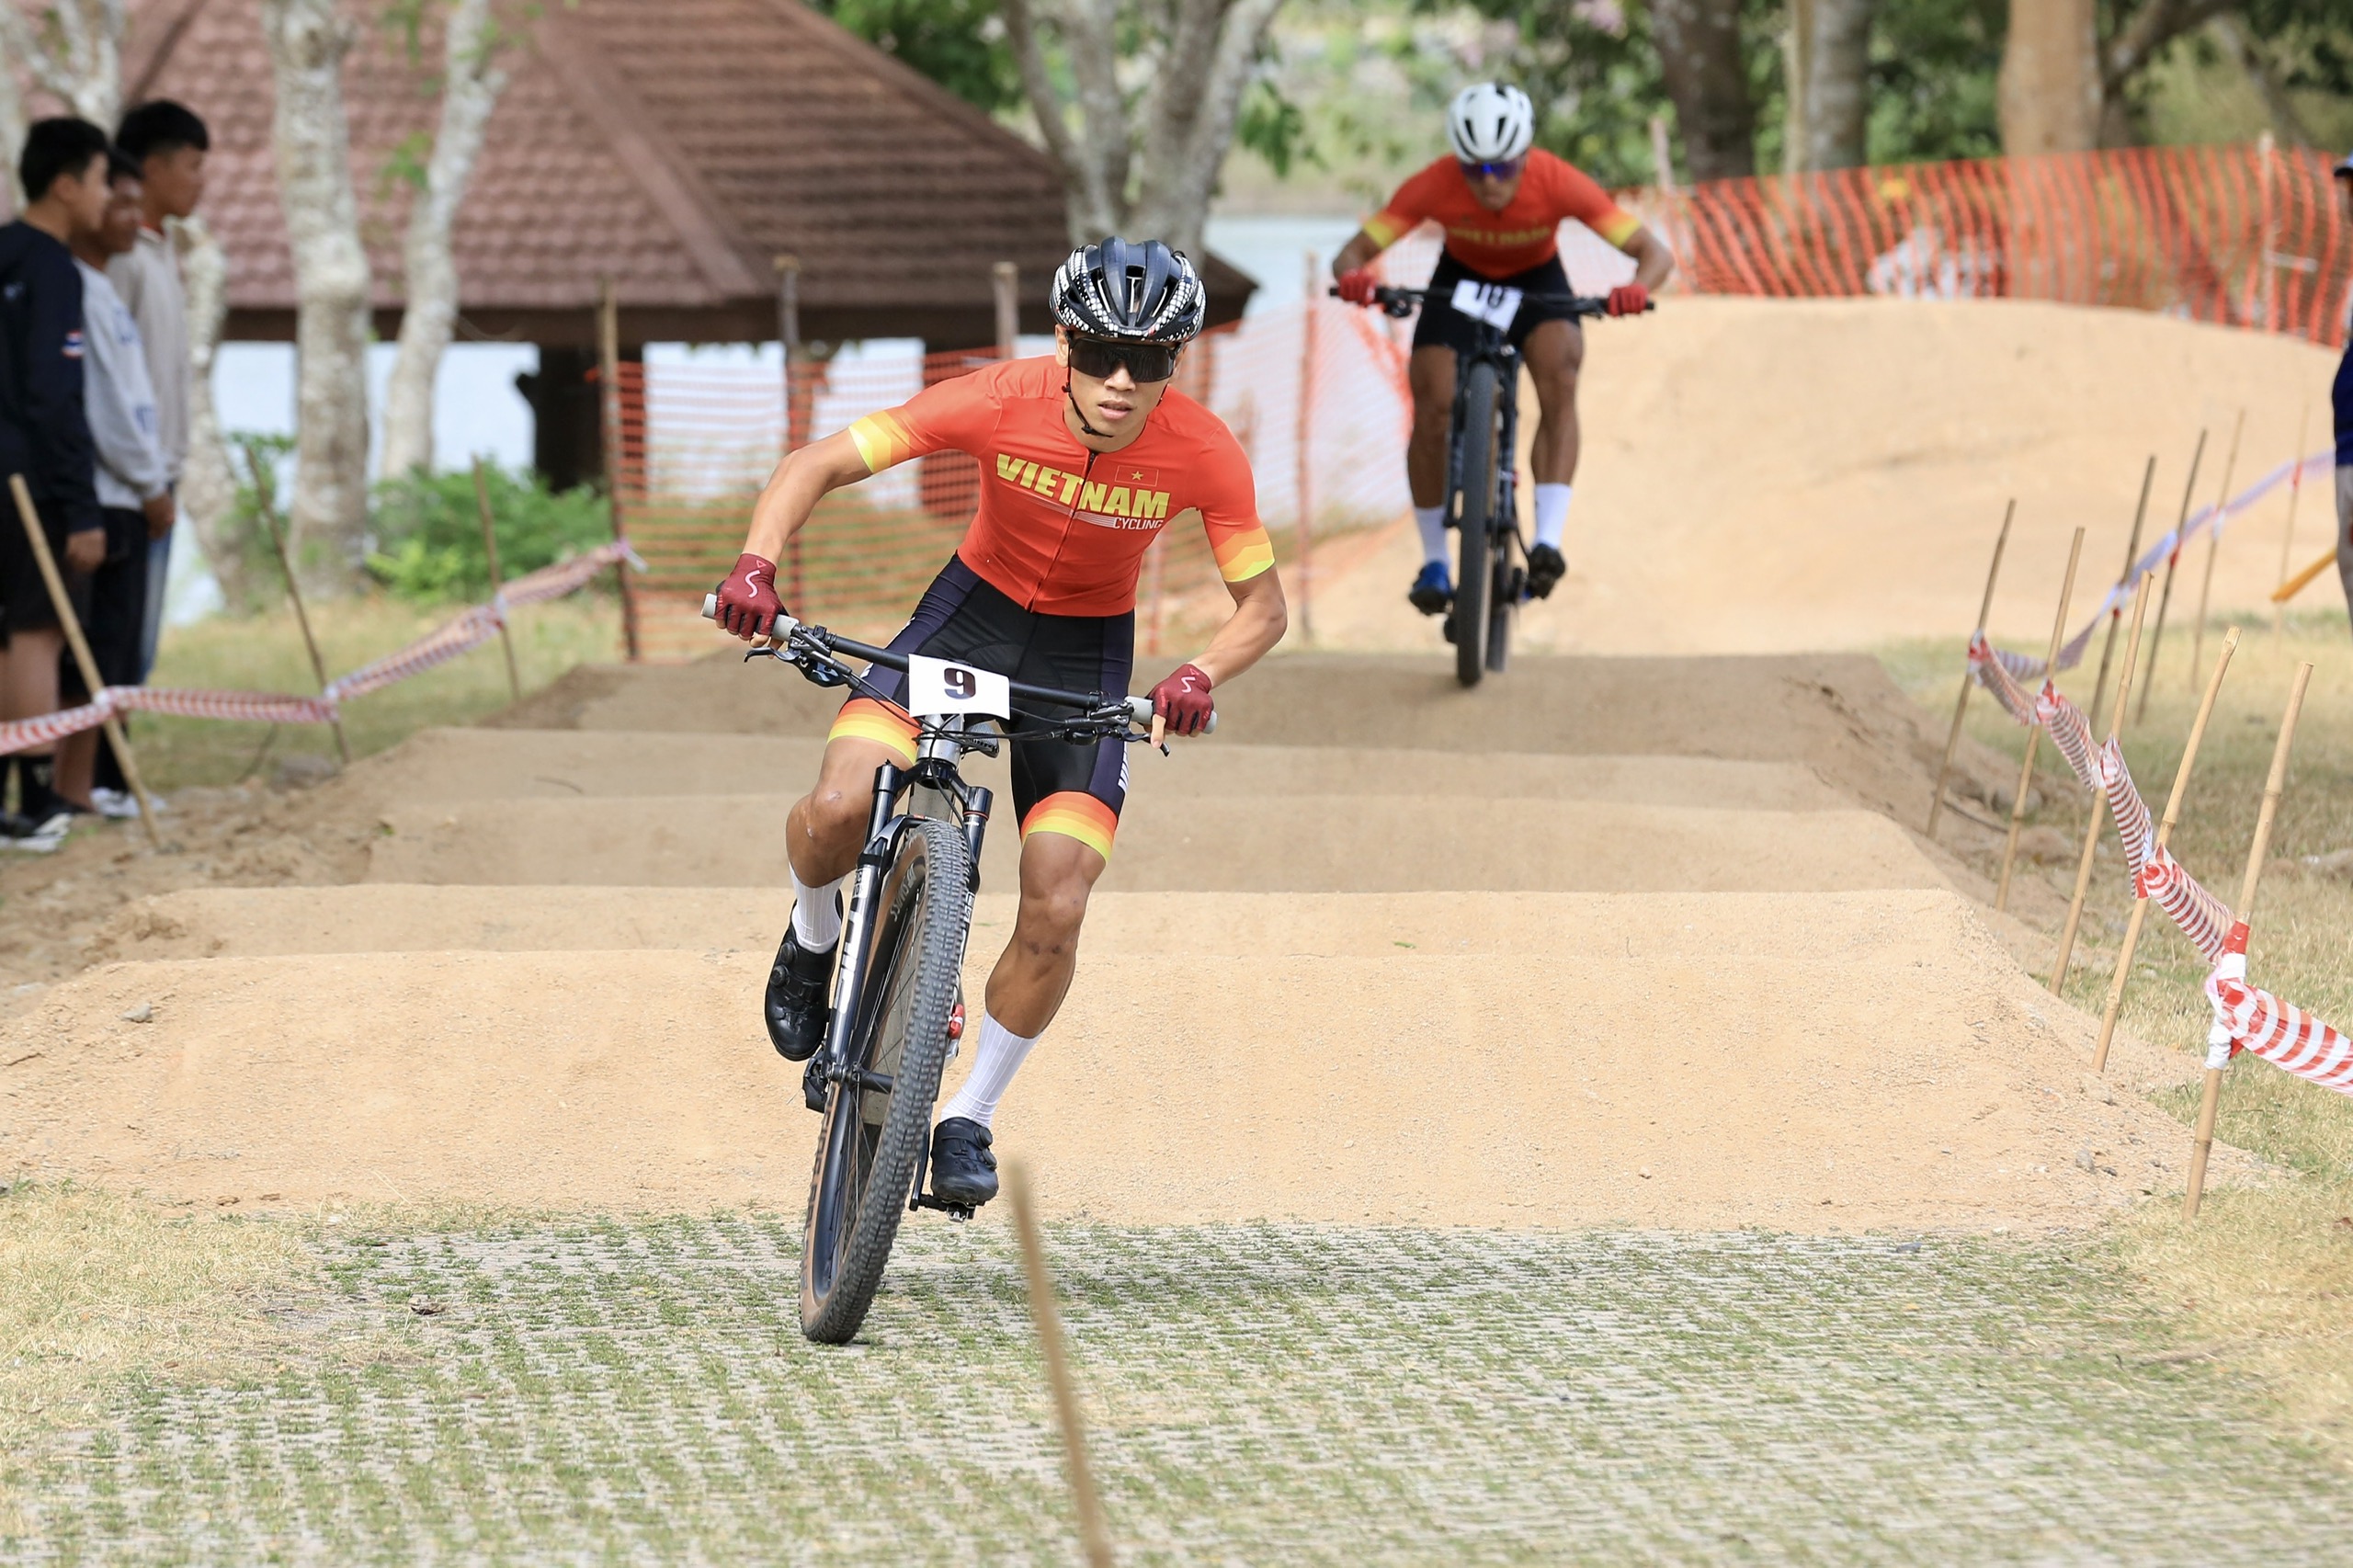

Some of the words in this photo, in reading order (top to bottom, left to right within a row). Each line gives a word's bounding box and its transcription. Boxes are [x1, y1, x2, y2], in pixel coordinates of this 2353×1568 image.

[996, 453, 1170, 518] VIETNAM
[1113, 517, 1164, 530] CYCLING
[944, 667, 976, 699] 9
